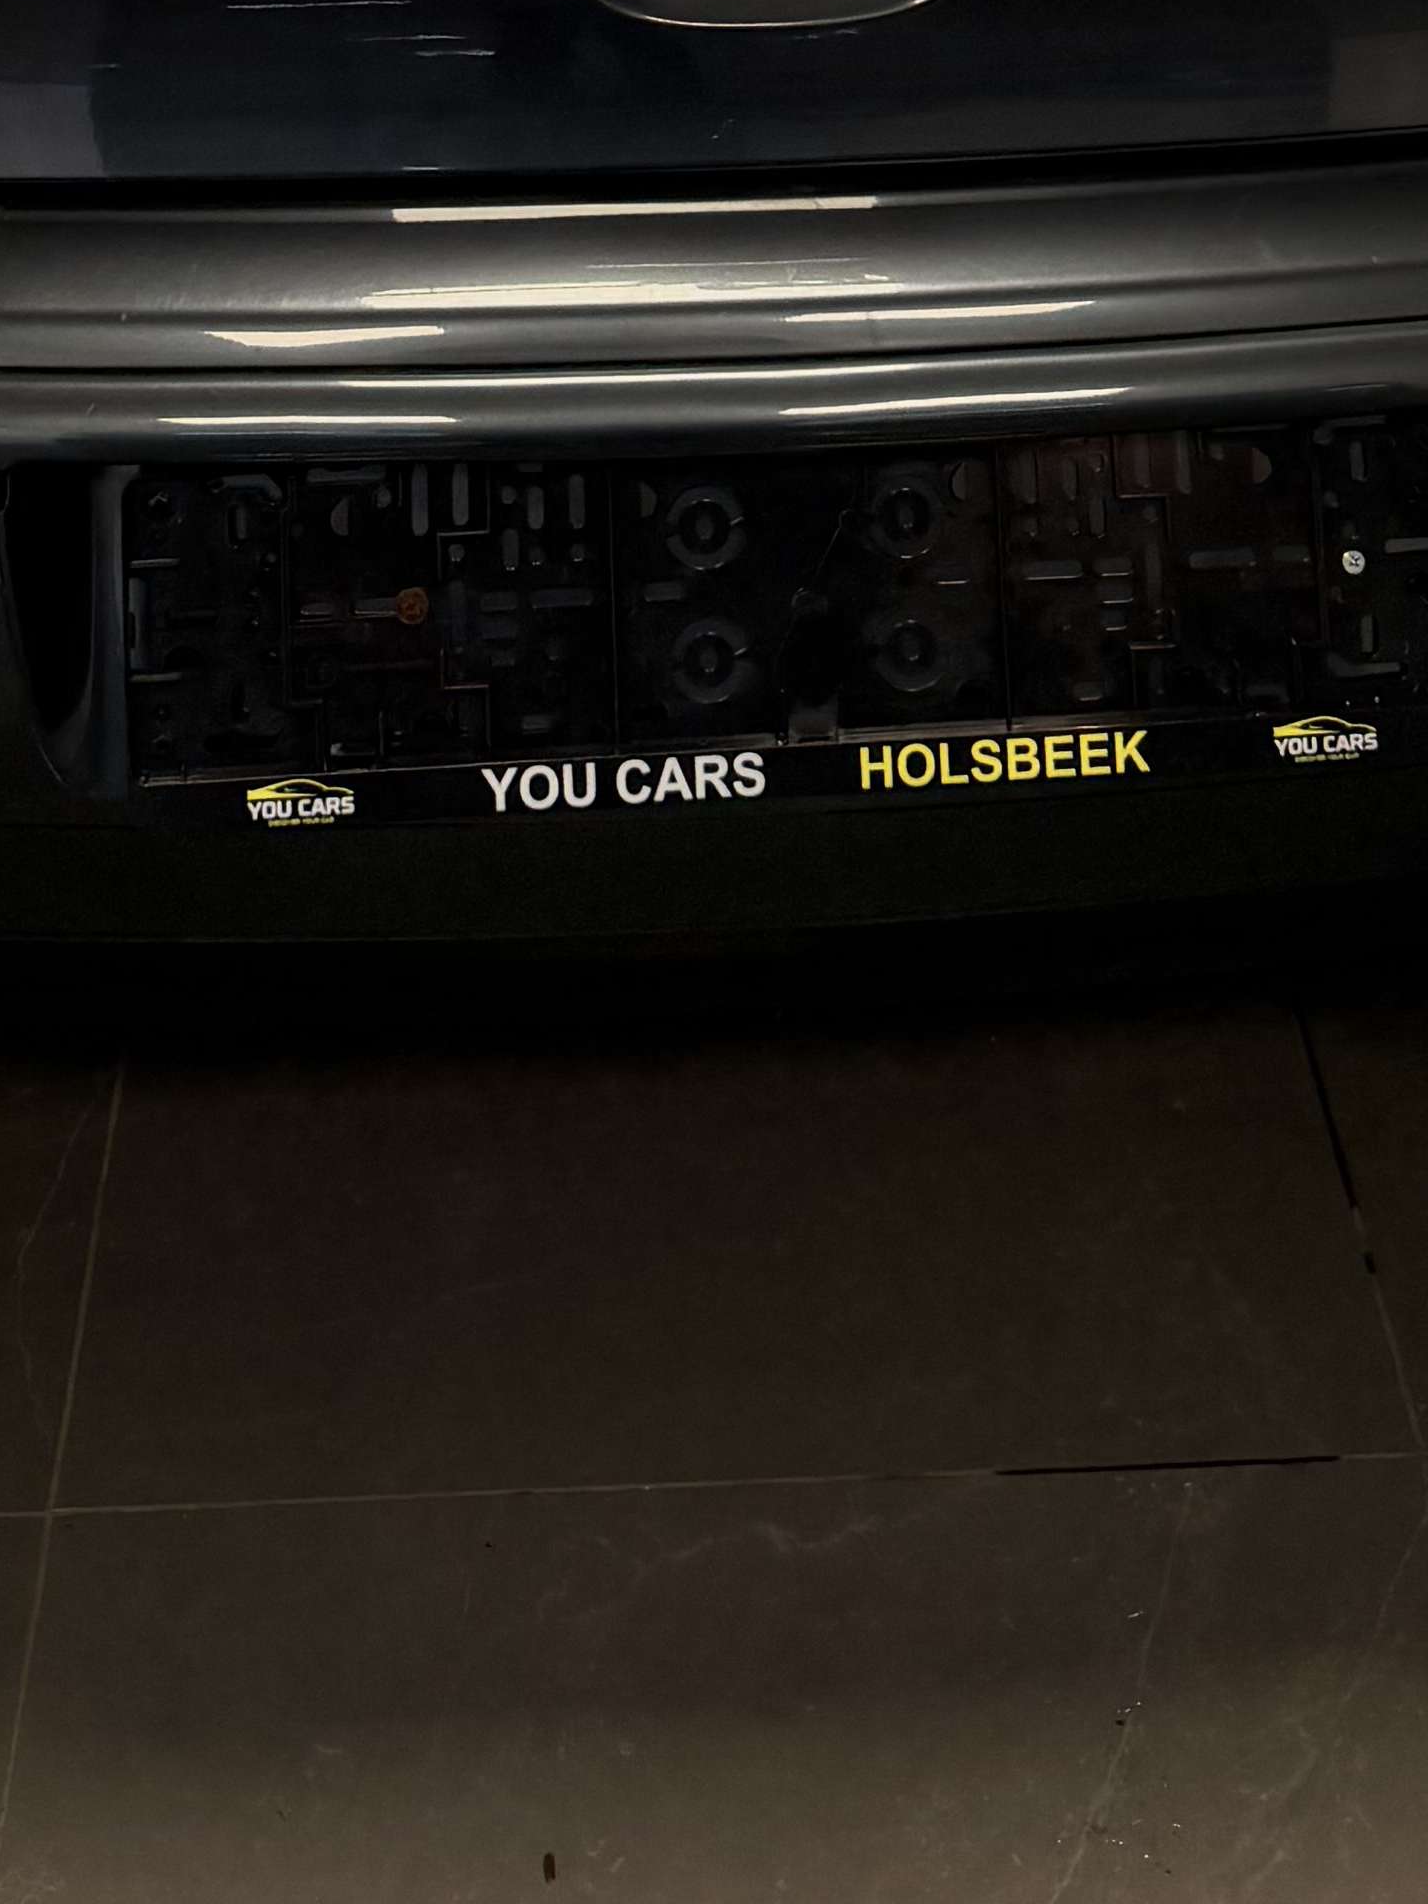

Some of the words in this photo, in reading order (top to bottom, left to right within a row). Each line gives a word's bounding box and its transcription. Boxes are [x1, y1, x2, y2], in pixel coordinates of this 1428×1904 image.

[860, 730, 1150, 790] HOLSBEEK
[1274, 736, 1318, 757] YOU
[1323, 733, 1379, 752] CARS
[481, 762, 596, 812] YOU
[616, 752, 766, 804] CARS
[247, 800, 293, 821] YOU
[297, 795, 356, 817] CARS
